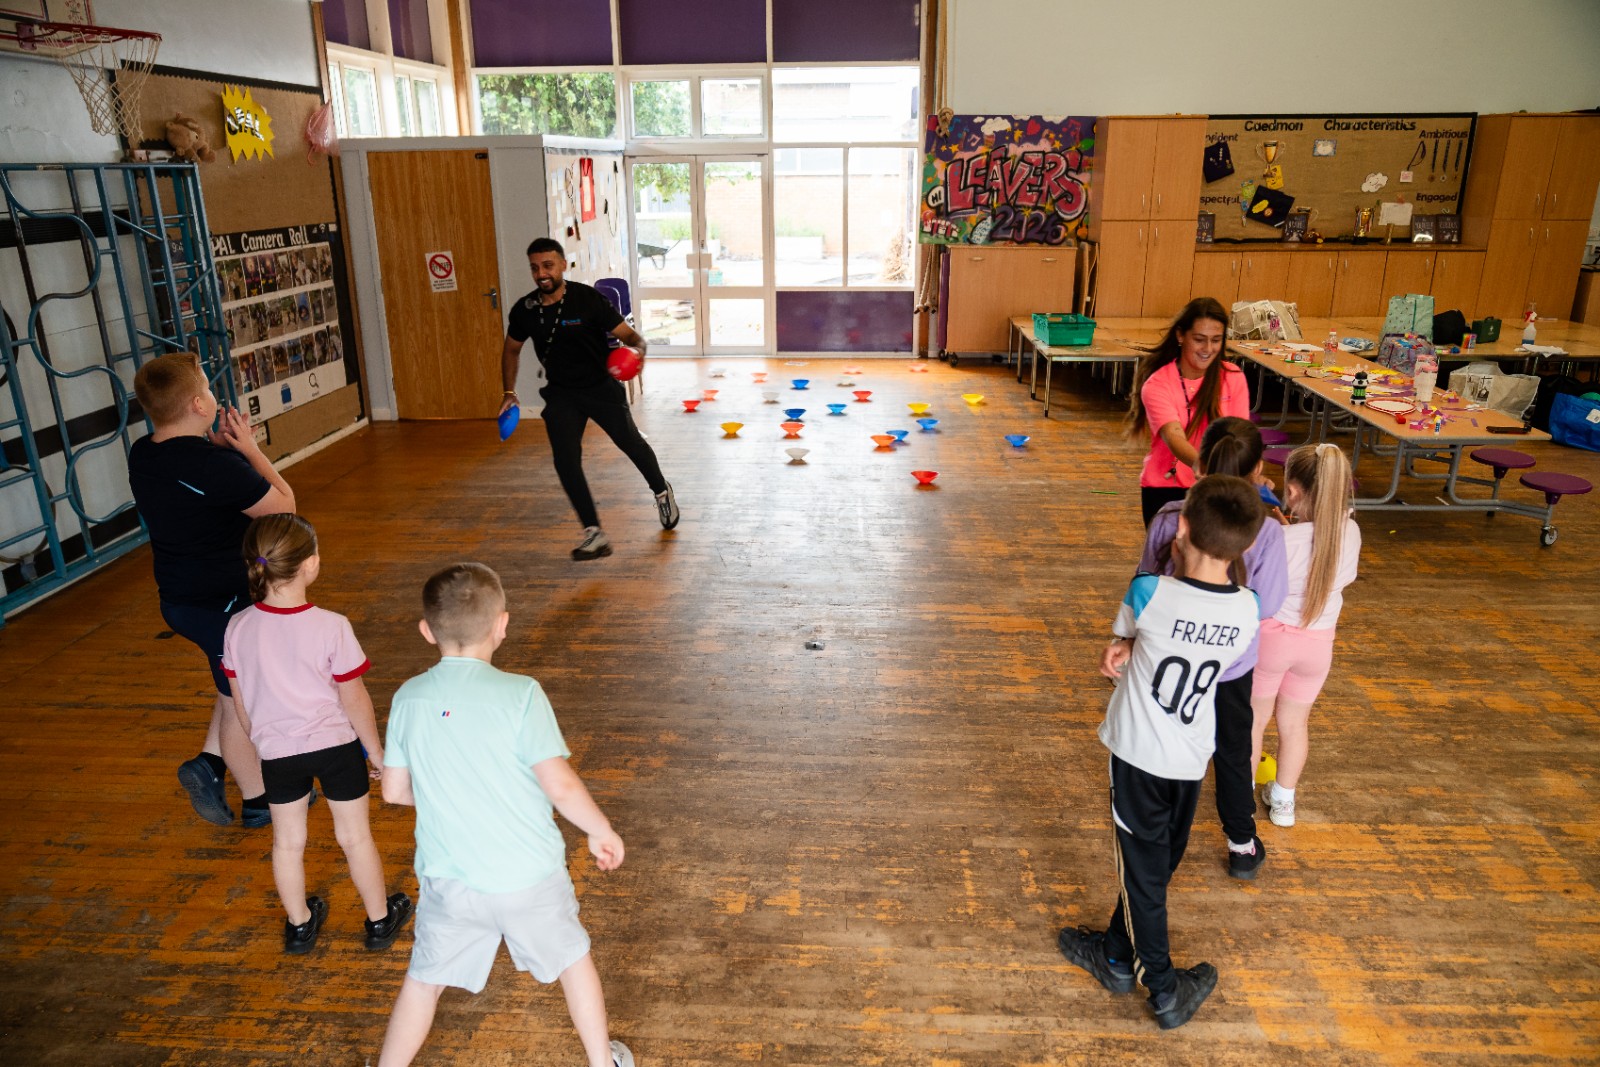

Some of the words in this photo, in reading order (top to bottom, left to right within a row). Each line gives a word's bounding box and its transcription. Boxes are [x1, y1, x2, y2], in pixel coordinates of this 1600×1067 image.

[1244, 119, 1304, 132] Caedmon
[1323, 119, 1417, 132] Characteristics
[1205, 132, 1239, 143] nfident
[1418, 129, 1469, 139] Ambitious
[944, 144, 1088, 222] LEAVERS
[931, 189, 942, 203] HI
[1200, 195, 1241, 206] spectful
[1415, 193, 1458, 203] Engaged
[990, 204, 1068, 245] 2026
[211, 235, 236, 257] PAL
[240, 232, 285, 253] Camera
[288, 226, 310, 247] Roll
[1171, 618, 1240, 648] FRAZER
[1151, 655, 1221, 725] 08
